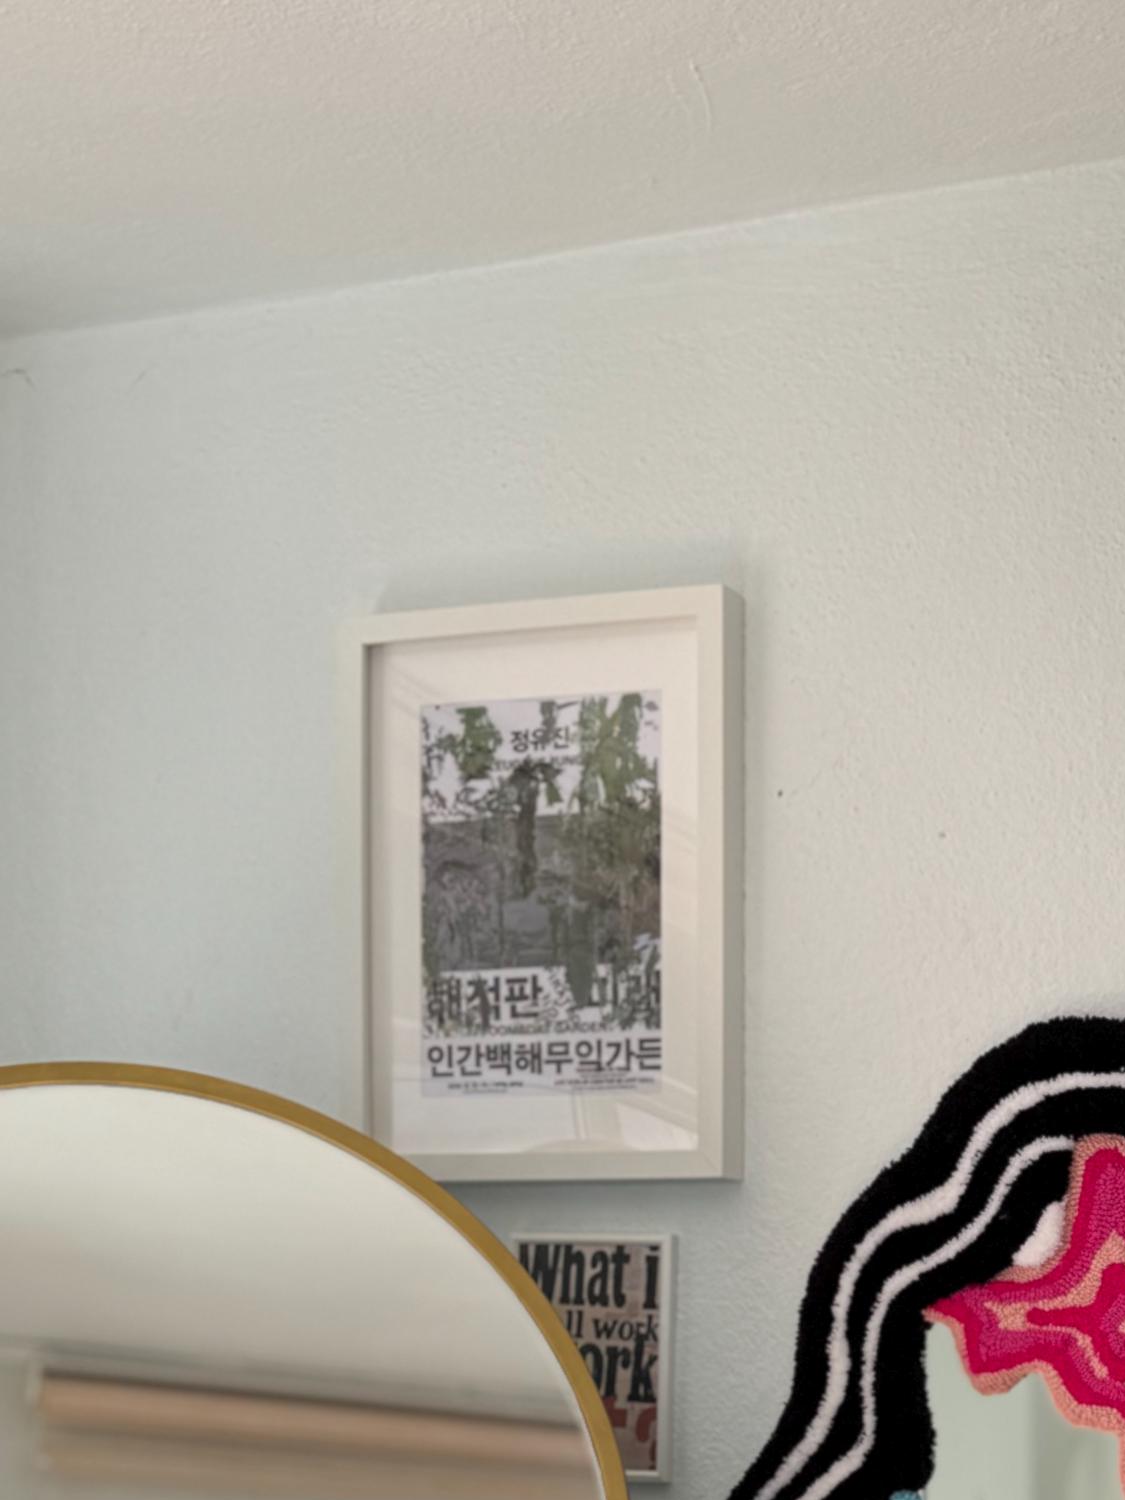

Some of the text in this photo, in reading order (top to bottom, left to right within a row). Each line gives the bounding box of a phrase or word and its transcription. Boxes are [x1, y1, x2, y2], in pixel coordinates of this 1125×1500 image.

[511, 726, 570, 752] 정유진
[428, 1037, 662, 1078] 인간백해무익가든
[519, 1243, 630, 1308] What
[592, 1314, 659, 1342] work
[577, 1333, 658, 1402] ork
